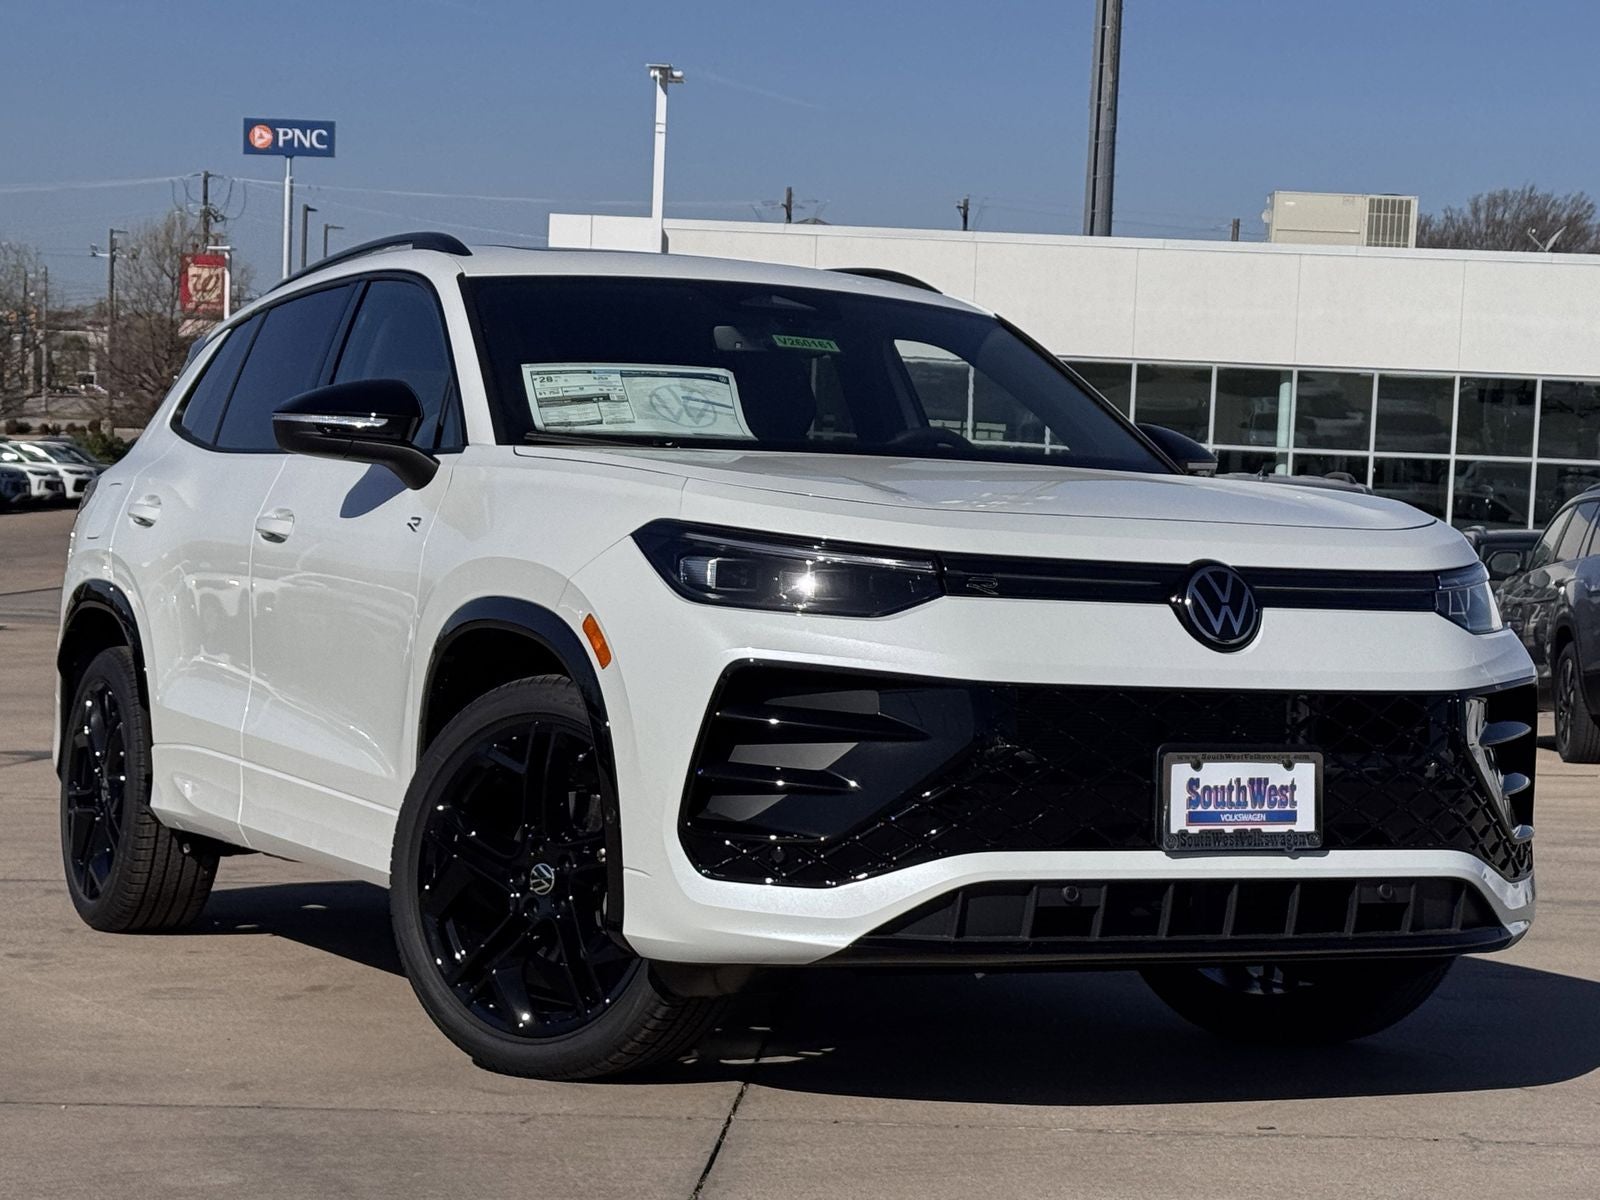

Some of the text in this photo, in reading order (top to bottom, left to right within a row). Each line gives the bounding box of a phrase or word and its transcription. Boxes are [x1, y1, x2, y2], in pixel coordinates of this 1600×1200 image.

[276, 127, 328, 149] PNC
[1186, 777, 1298, 810] SouthWest
[1220, 813, 1266, 822] VOLKSWAGEN
